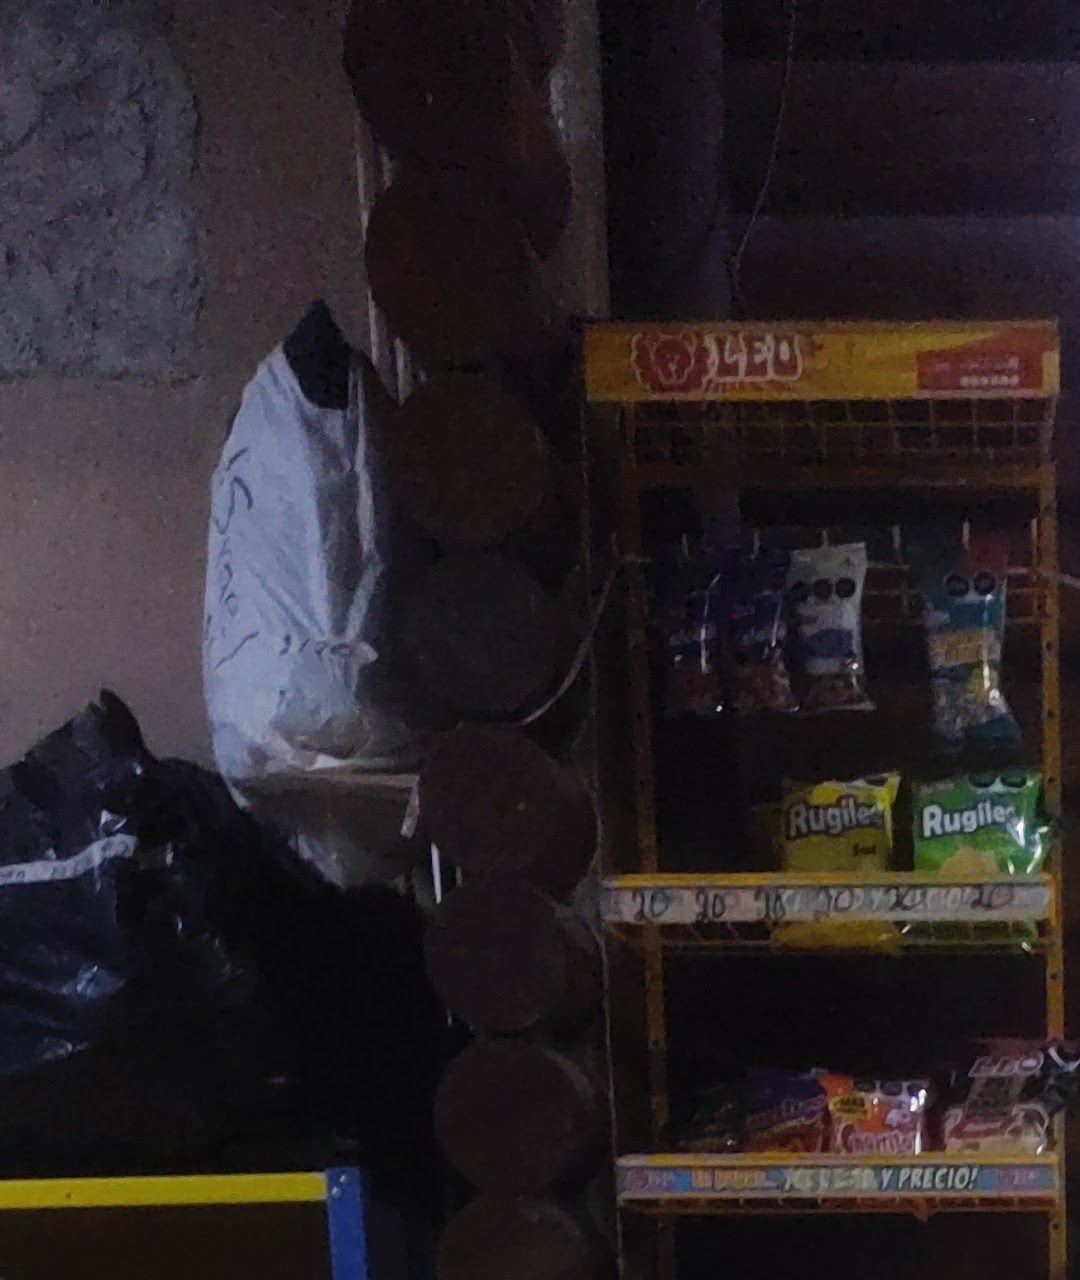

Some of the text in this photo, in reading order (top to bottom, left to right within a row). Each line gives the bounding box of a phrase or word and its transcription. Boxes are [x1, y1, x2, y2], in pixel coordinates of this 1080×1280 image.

[706, 333, 803, 382] LEO
[880, 1167, 893, 1189] Y
[897, 1166, 979, 1189] PRECIO!
